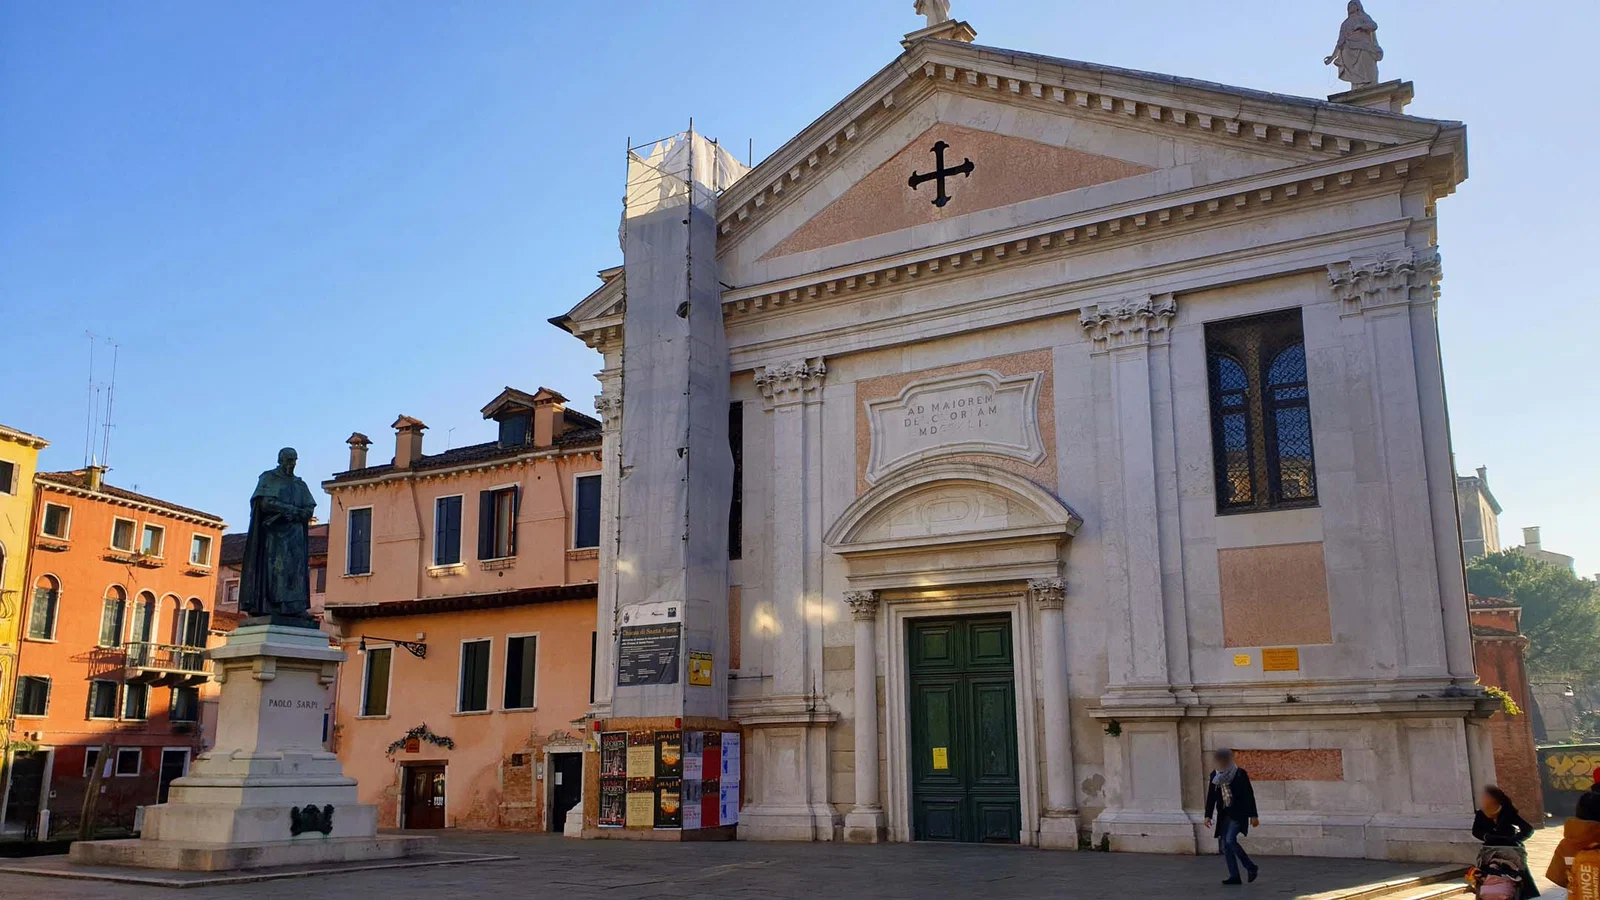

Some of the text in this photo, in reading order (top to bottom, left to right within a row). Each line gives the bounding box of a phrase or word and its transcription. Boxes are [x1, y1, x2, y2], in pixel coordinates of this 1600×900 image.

[907, 394, 993, 416] AD MAIOREM
[268, 699, 318, 709] PAOLO SARPI
